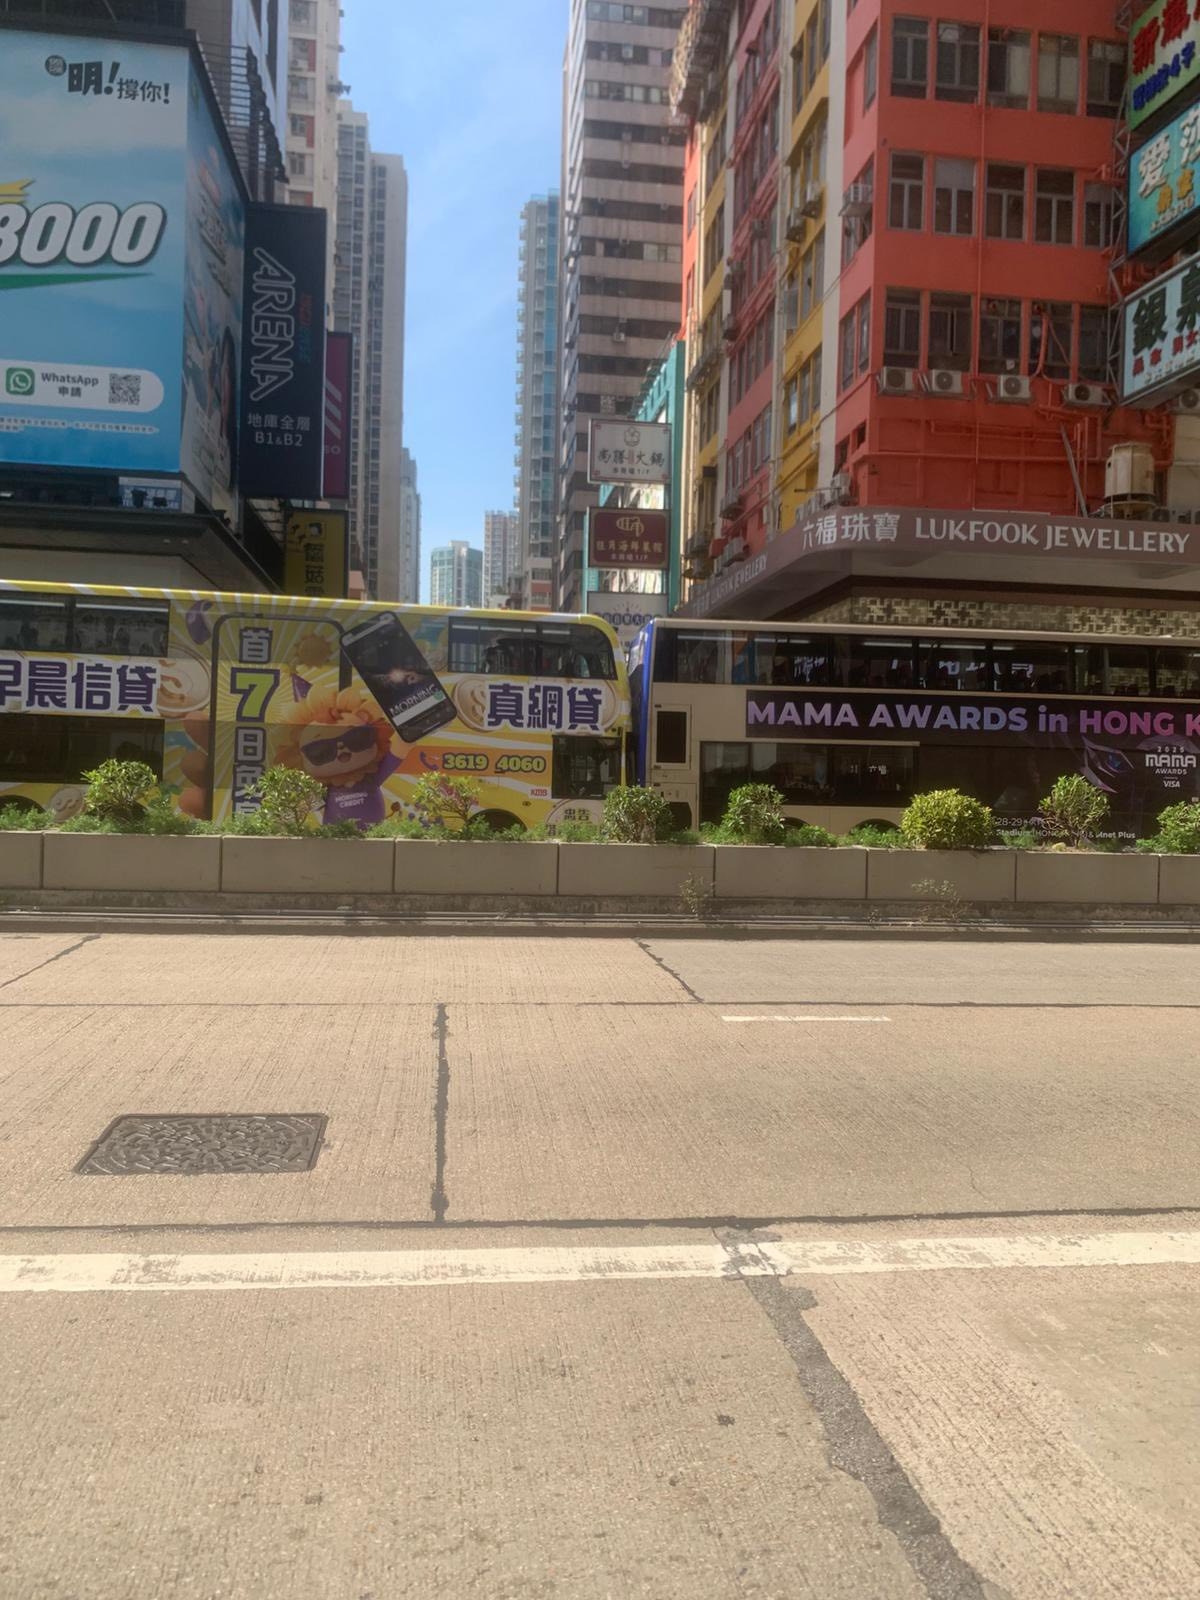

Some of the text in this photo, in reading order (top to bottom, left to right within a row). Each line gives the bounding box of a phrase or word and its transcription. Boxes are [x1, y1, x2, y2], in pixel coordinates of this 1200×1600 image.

[249, 247, 296, 402] ARENA
[41, 372, 99, 387] WhatsApp
[254, 432, 303, 447] B1&B2
[802, 512, 899, 550] 六福珠寶
[914, 517, 1190, 554] LUKFOOK JEWELLERY
[0, 659, 157, 712] 早晨信貸
[487, 684, 603, 731] 真網貸
[747, 701, 859, 728] MAMA
[868, 703, 1028, 733] AWARDS
[1038, 705, 1068, 733] in
[1079, 709, 1175, 736] HONG
[443, 753, 546, 773] 3619 4060
[1145, 754, 1197, 768] MAMA
[1155, 768, 1187, 776] AWARDS
[1163, 780, 1181, 788] VISA
